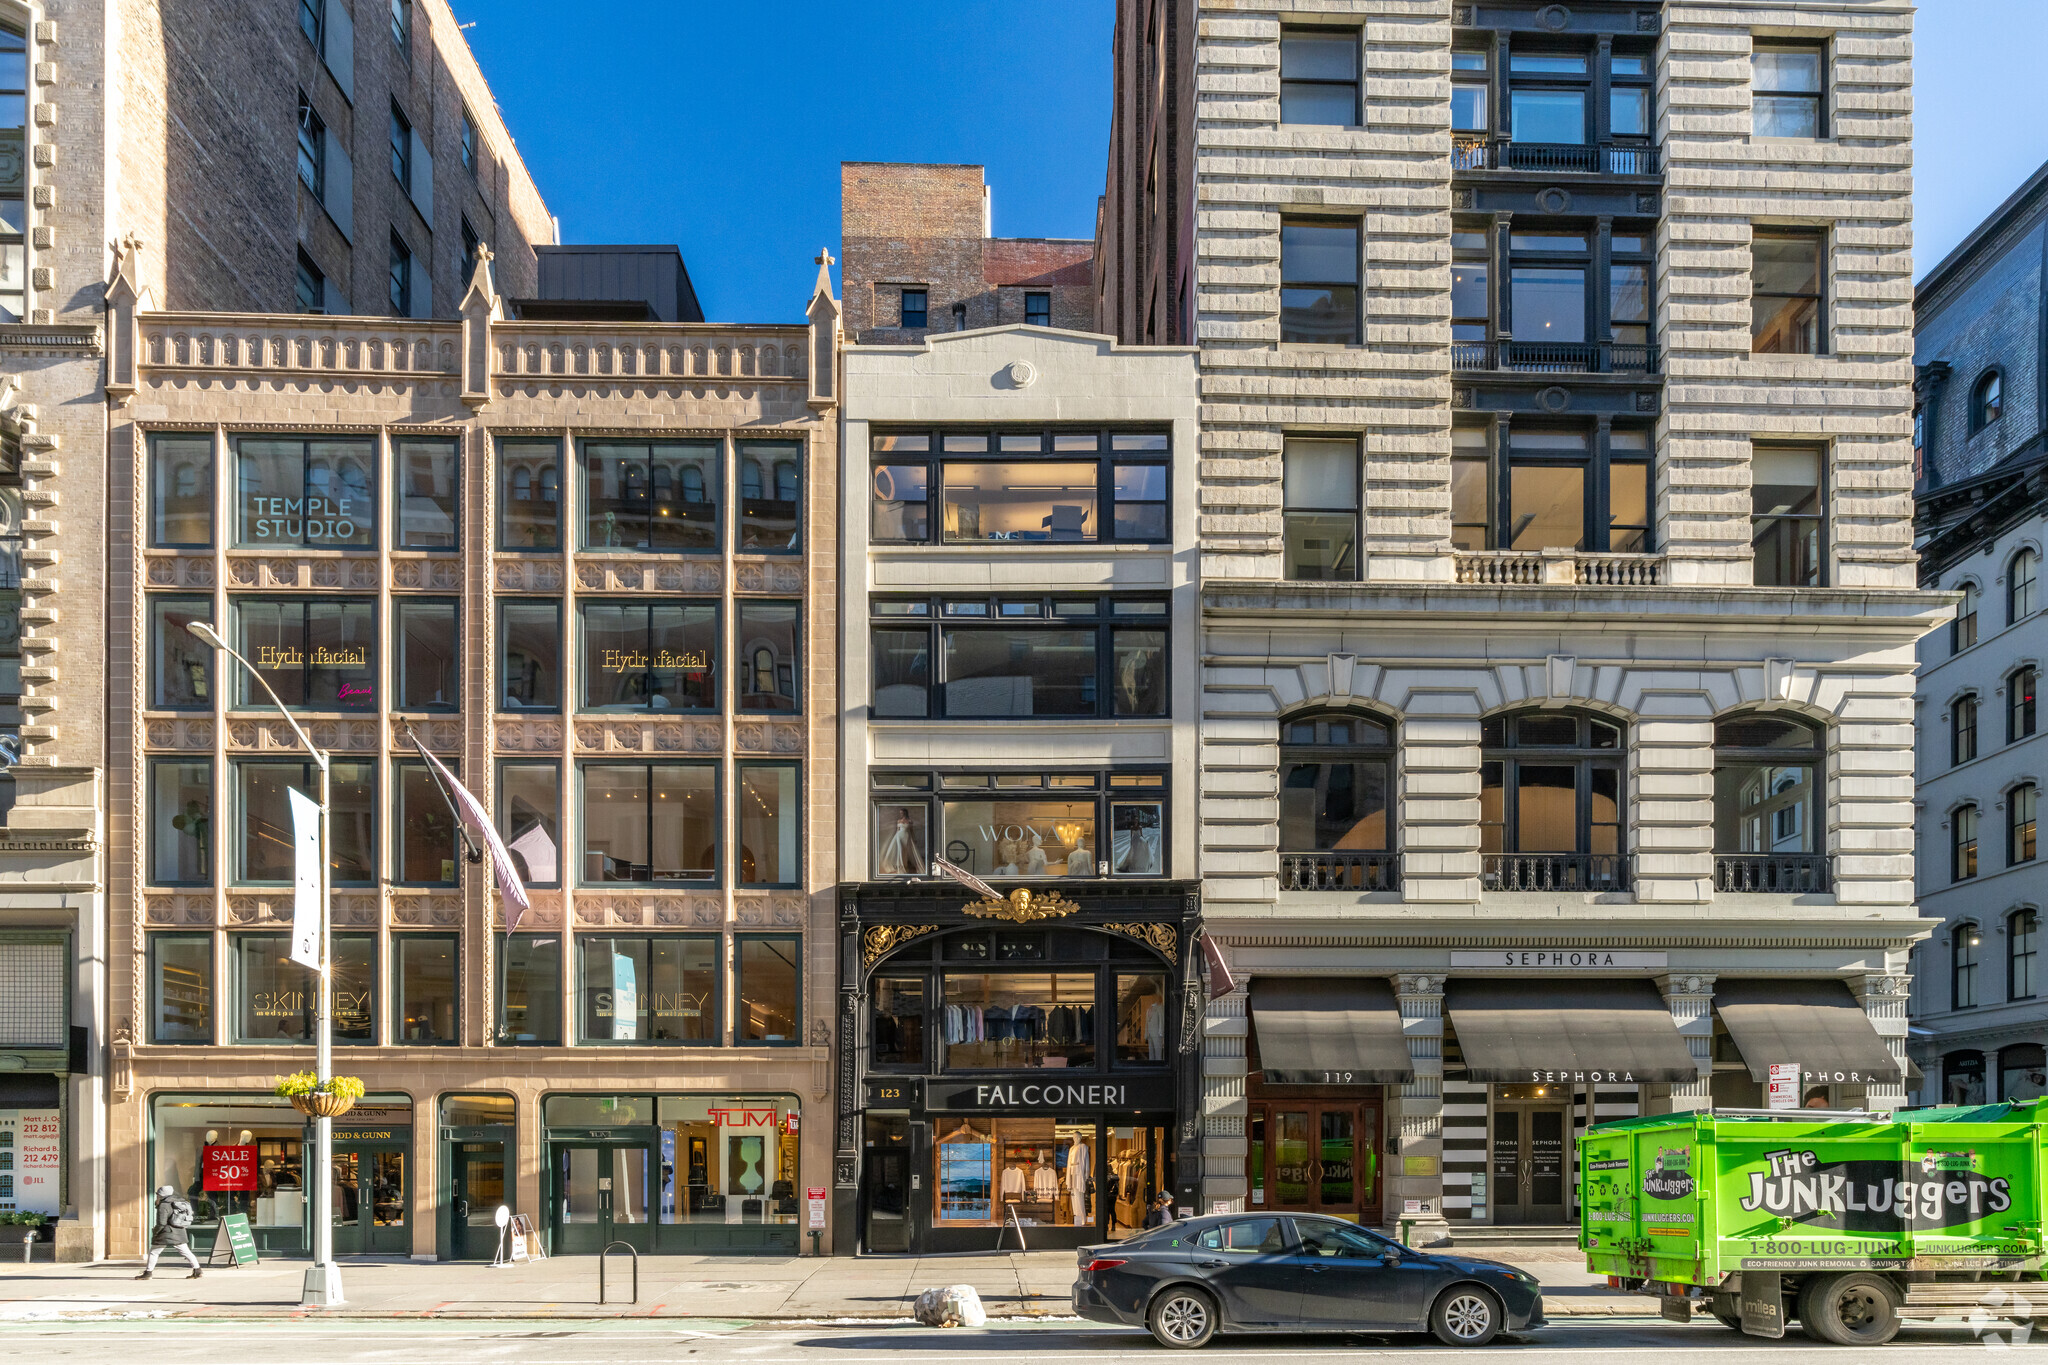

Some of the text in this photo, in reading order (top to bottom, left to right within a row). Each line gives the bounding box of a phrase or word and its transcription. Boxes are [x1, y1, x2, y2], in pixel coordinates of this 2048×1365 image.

[254, 497, 352, 516] TEMPLE
[256, 519, 354, 538] STUDIO
[1506, 952, 1614, 966] SEPHORA
[595, 992, 708, 1010] SNNEY
[1325, 1072, 1352, 1082] 119
[1532, 1072, 1633, 1082] SEPHORA
[880, 1089, 900, 1098] 123
[977, 1085, 1124, 1104] FALCONERI
[708, 1108, 776, 1126] TUMI
[212, 1150, 249, 1161] SALE
[1750, 1242, 1902, 1254] 1-800-LUG-JUNK
[1924, 1244, 2028, 1253] JUNKLUGGERS.COM
[1746, 1299, 1776, 1316] milea
